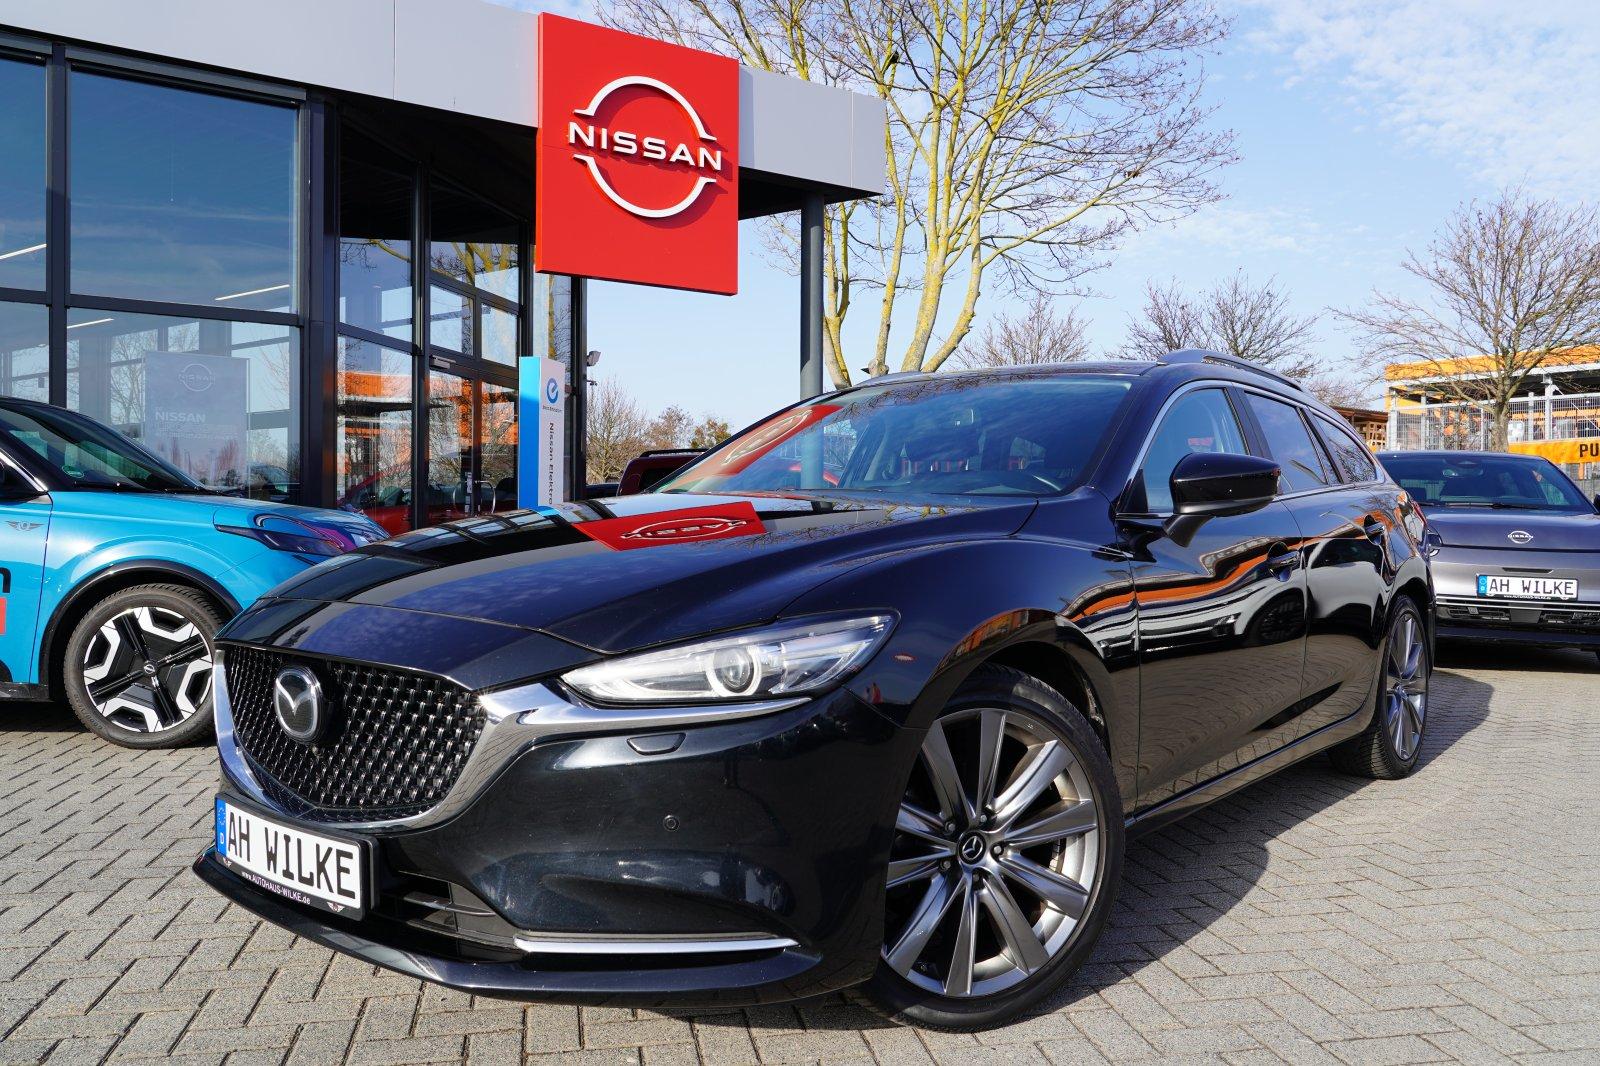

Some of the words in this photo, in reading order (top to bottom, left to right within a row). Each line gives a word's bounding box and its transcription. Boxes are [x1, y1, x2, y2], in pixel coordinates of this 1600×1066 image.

[568, 121, 722, 171] NISSAN
[155, 411, 206, 423] NISSAN
[1579, 443, 1599, 458] PU
[1489, 578, 1510, 593] AH
[1521, 580, 1574, 596] WILKE
[228, 811, 251, 863] AH
[264, 826, 356, 900] WILKE
[241, 871, 311, 905] www.AUTOHAUS-WILKE.de
